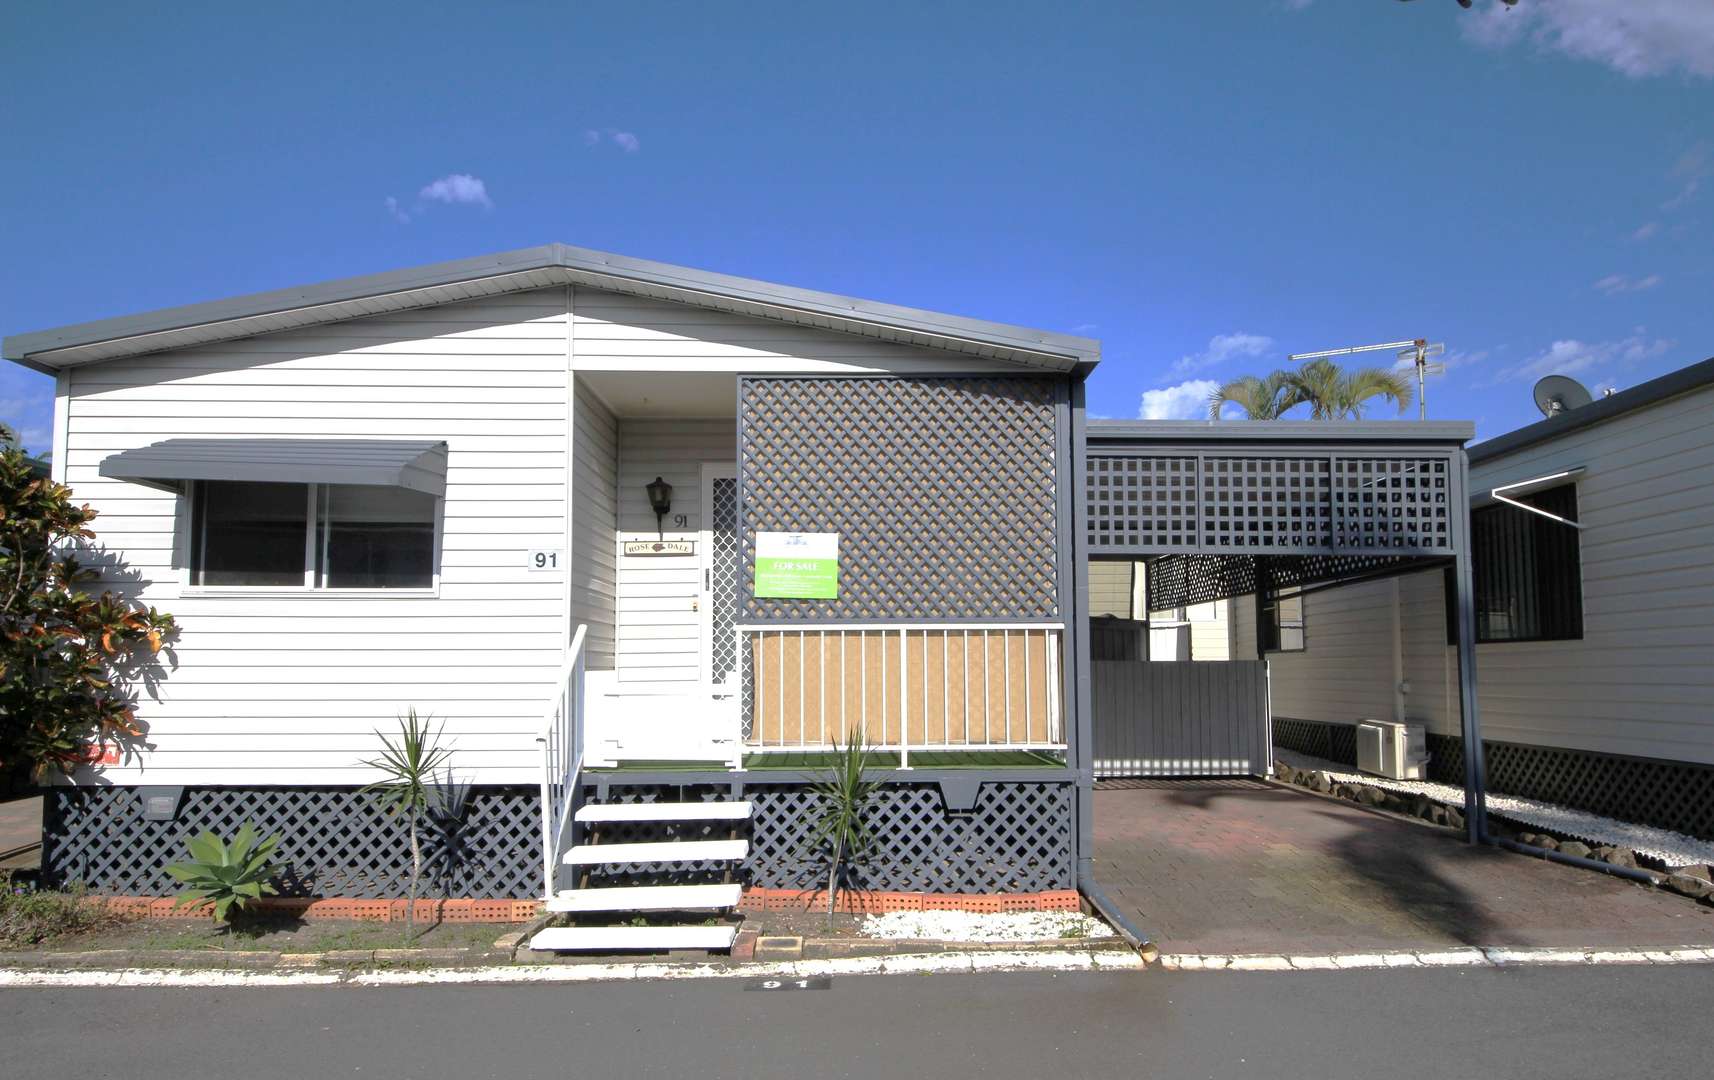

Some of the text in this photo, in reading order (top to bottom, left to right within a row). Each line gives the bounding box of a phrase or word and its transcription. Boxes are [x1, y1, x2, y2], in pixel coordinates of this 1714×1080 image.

[674, 514, 688, 528] 91
[628, 543, 689, 553] ROSE DALE
[535, 552, 556, 568] 91
[773, 561, 818, 571] FOR SALE
